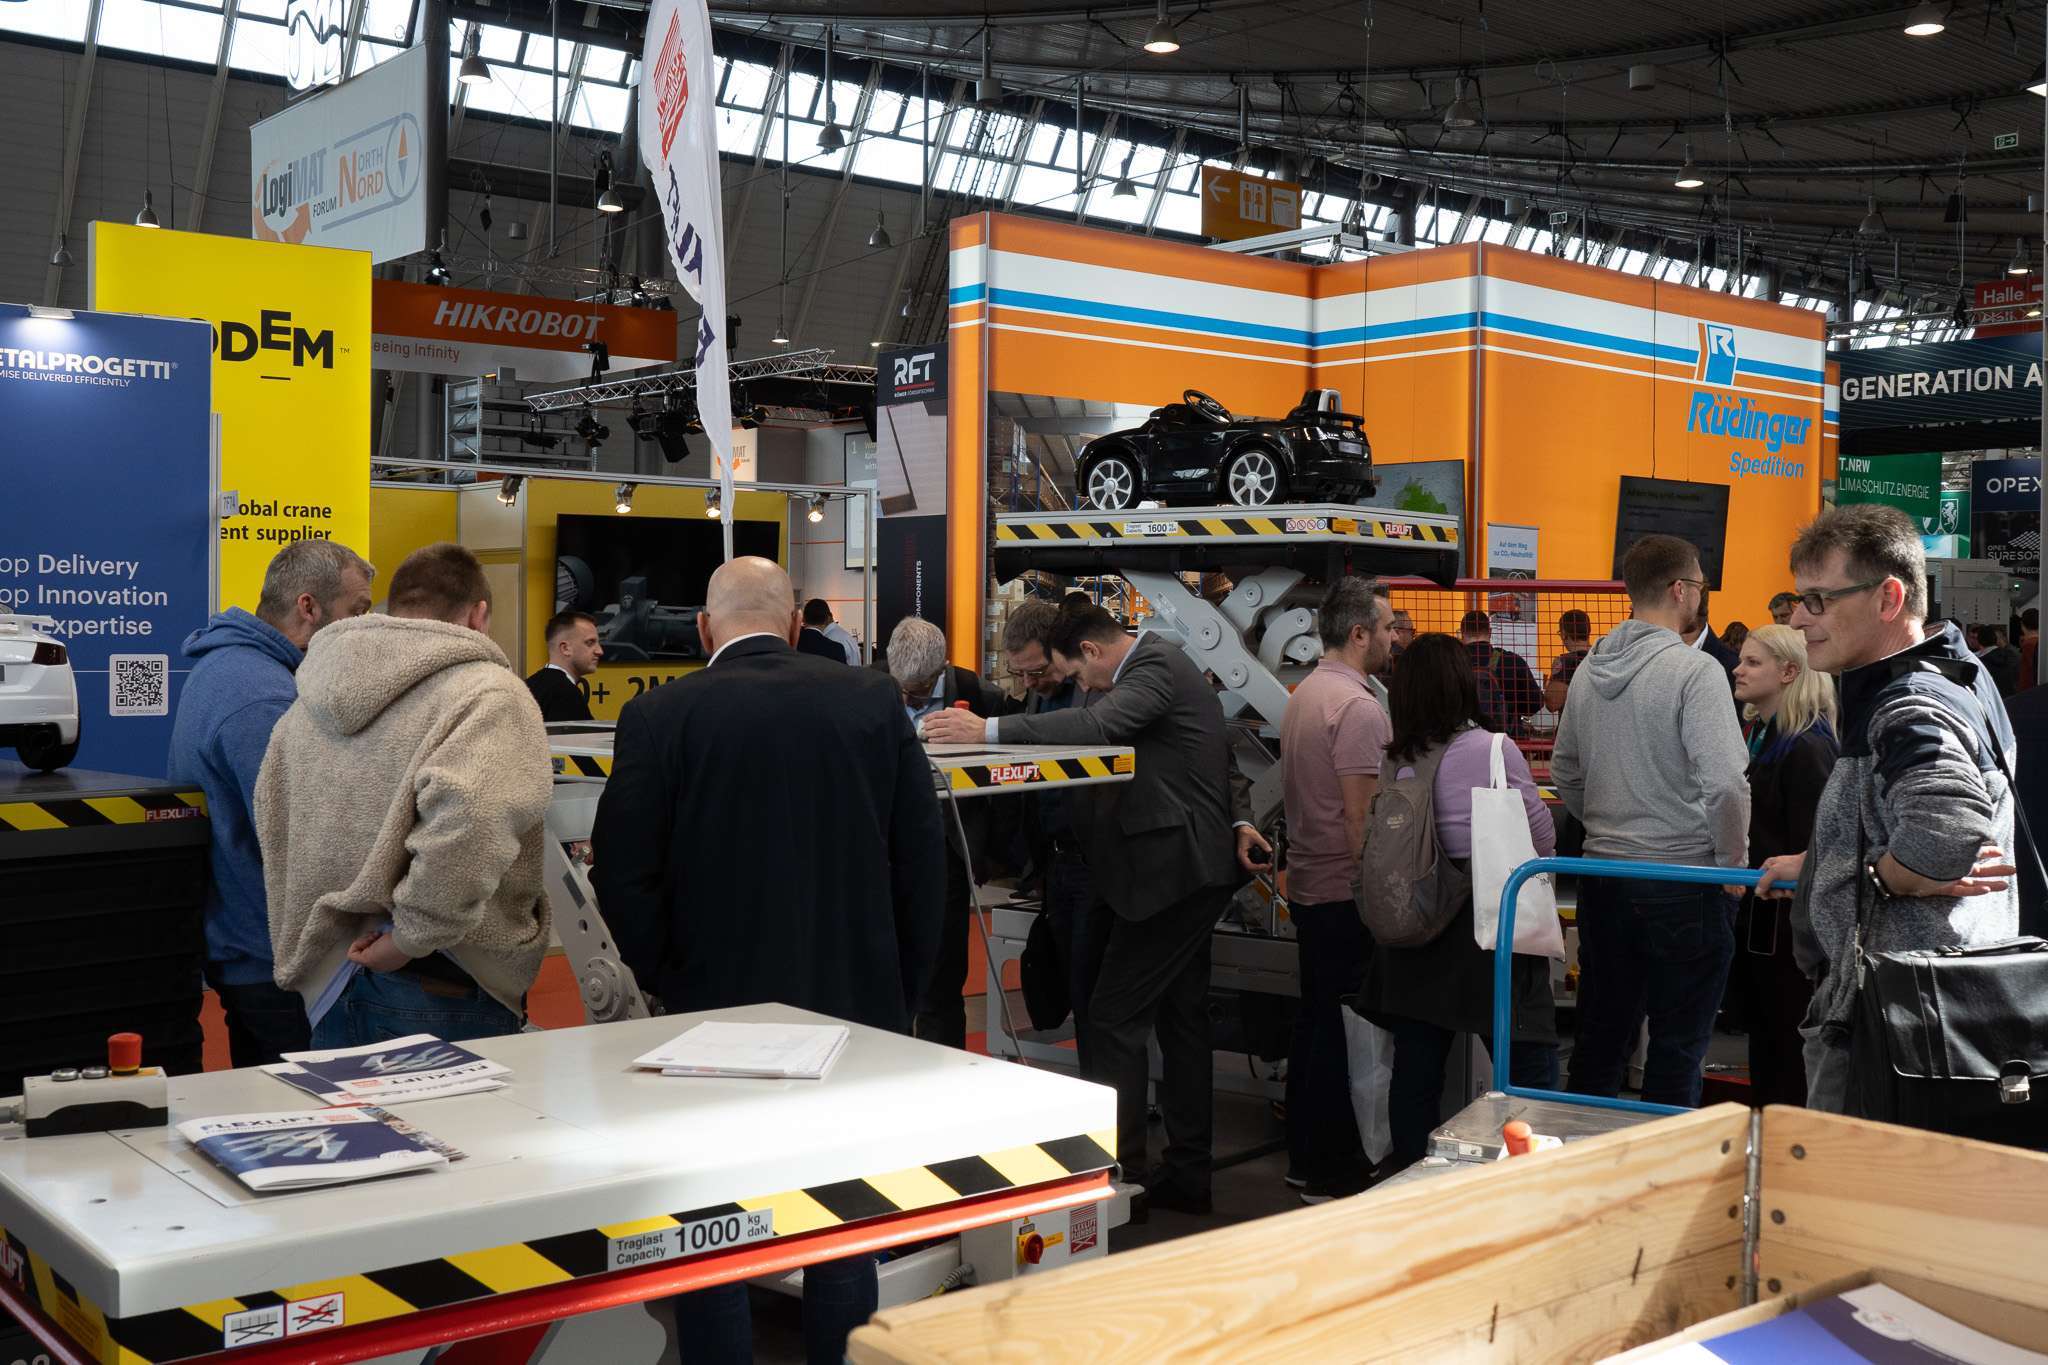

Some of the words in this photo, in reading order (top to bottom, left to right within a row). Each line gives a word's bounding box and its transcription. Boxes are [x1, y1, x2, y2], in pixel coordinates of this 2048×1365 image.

[263, 149, 327, 218] LogiMAT
[313, 196, 337, 217] FORUM
[1983, 286, 2025, 304] Halle
[433, 301, 605, 340] HIKROBOT
[414, 343, 461, 364] Infinity
[22, 371, 73, 384] DELIVERED
[74, 376, 130, 387] EFFICIENTLY
[894, 353, 935, 386] RFT
[1842, 365, 2013, 401] GENERATION
[1687, 391, 1811, 452] Rüdinger
[1729, 452, 1804, 478] Spedition
[283, 504, 332, 518] crane
[256, 525, 332, 545] supplier
[1148, 523, 1168, 533] 1600
[1385, 523, 1412, 536] FLEXLIFT
[38, 554, 139, 580] Delivery
[38, 585, 168, 606] Innovation
[990, 764, 1040, 784] FLEXLIFT
[146, 807, 199, 821] FLEXLIFT
[201, 1116, 315, 1131] FLEXLIFT
[747, 1214, 761, 1225] kg
[675, 1217, 741, 1253] 1000
[747, 1224, 769, 1238] daN
[616, 1233, 664, 1251] Traglast
[616, 1247, 666, 1265] Capacity
